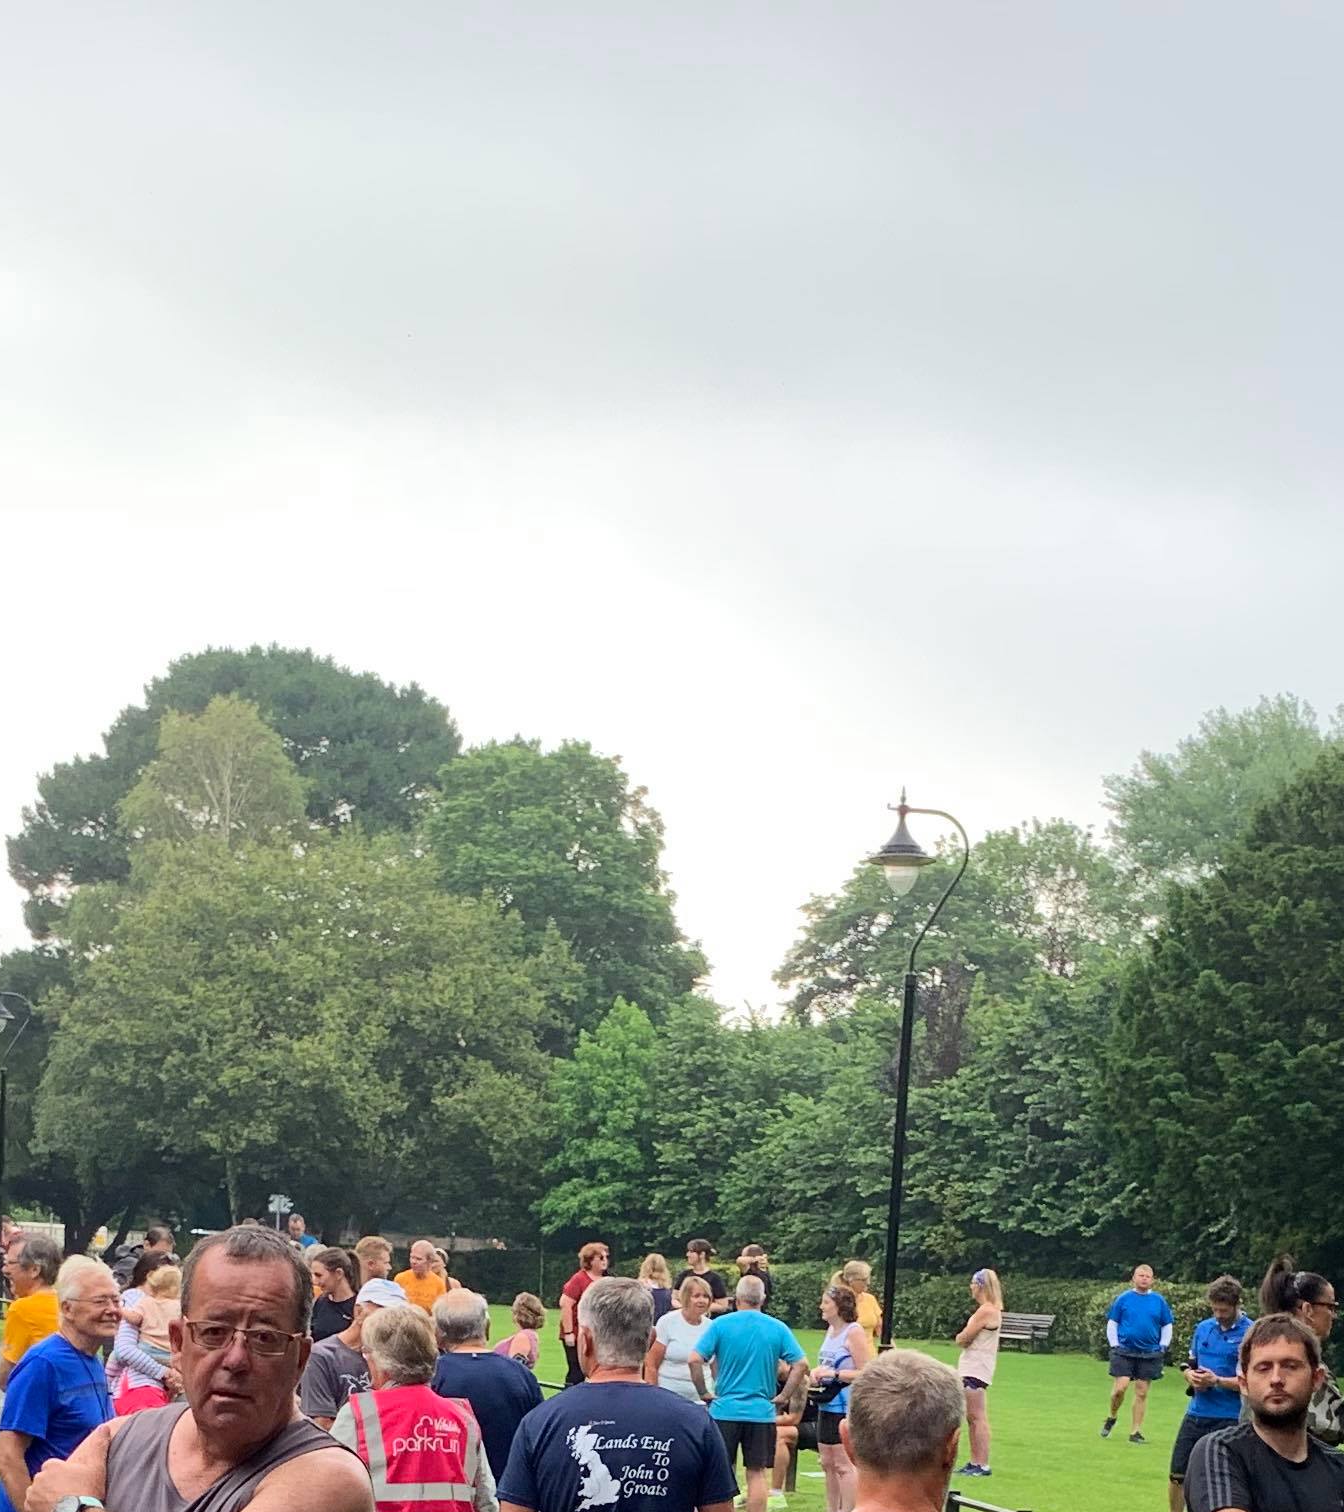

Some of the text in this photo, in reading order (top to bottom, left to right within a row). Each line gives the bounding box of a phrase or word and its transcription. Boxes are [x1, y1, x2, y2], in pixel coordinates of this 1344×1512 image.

[392, 1436, 460, 1457] parkrun
[595, 1433, 675, 1452] Lands End
[652, 1452, 670, 1467] To
[619, 1463, 670, 1482] John O
[623, 1480, 669, 1499] Groats
